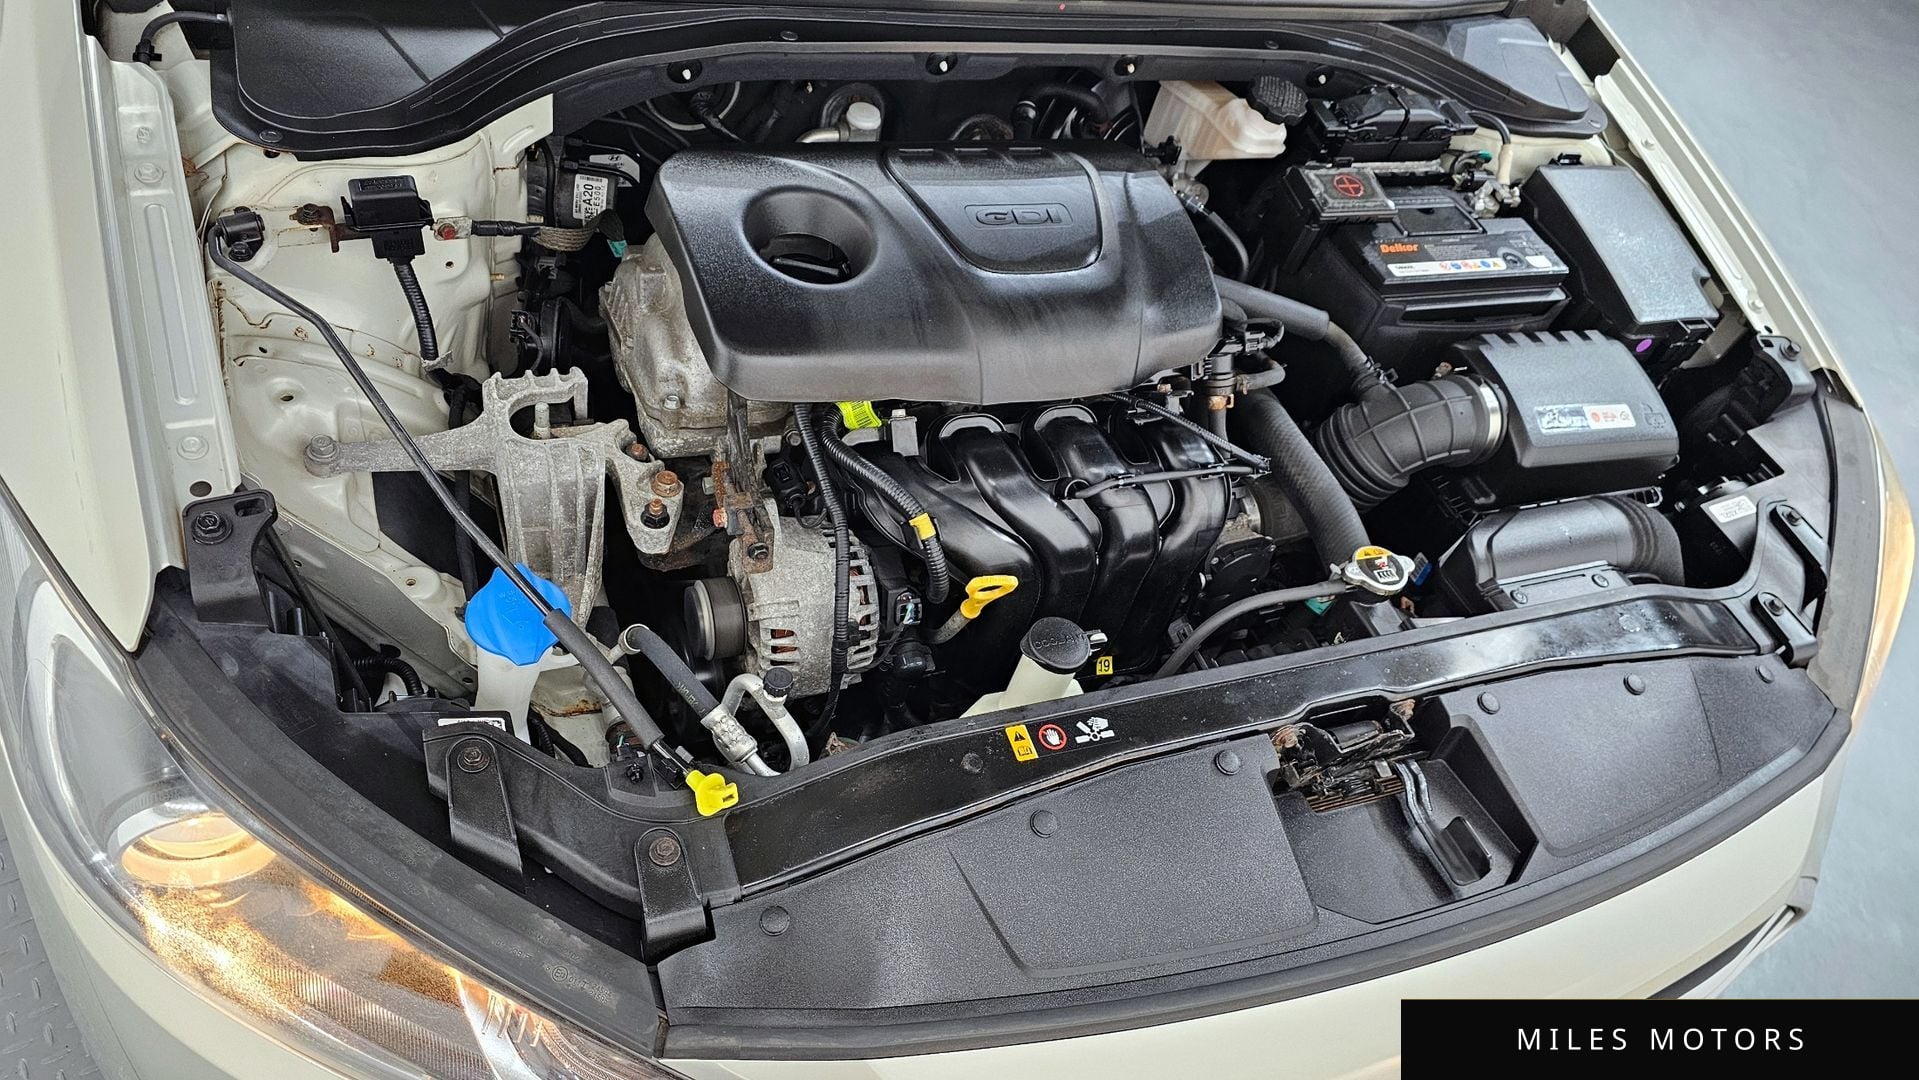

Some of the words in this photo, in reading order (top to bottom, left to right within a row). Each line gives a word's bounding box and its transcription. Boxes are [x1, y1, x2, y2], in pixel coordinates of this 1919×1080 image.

[583, 183, 594, 207] A20
[975, 207, 1063, 226] GDI
[1379, 242, 1420, 254] Delkor
[1098, 659, 1111, 673] 19
